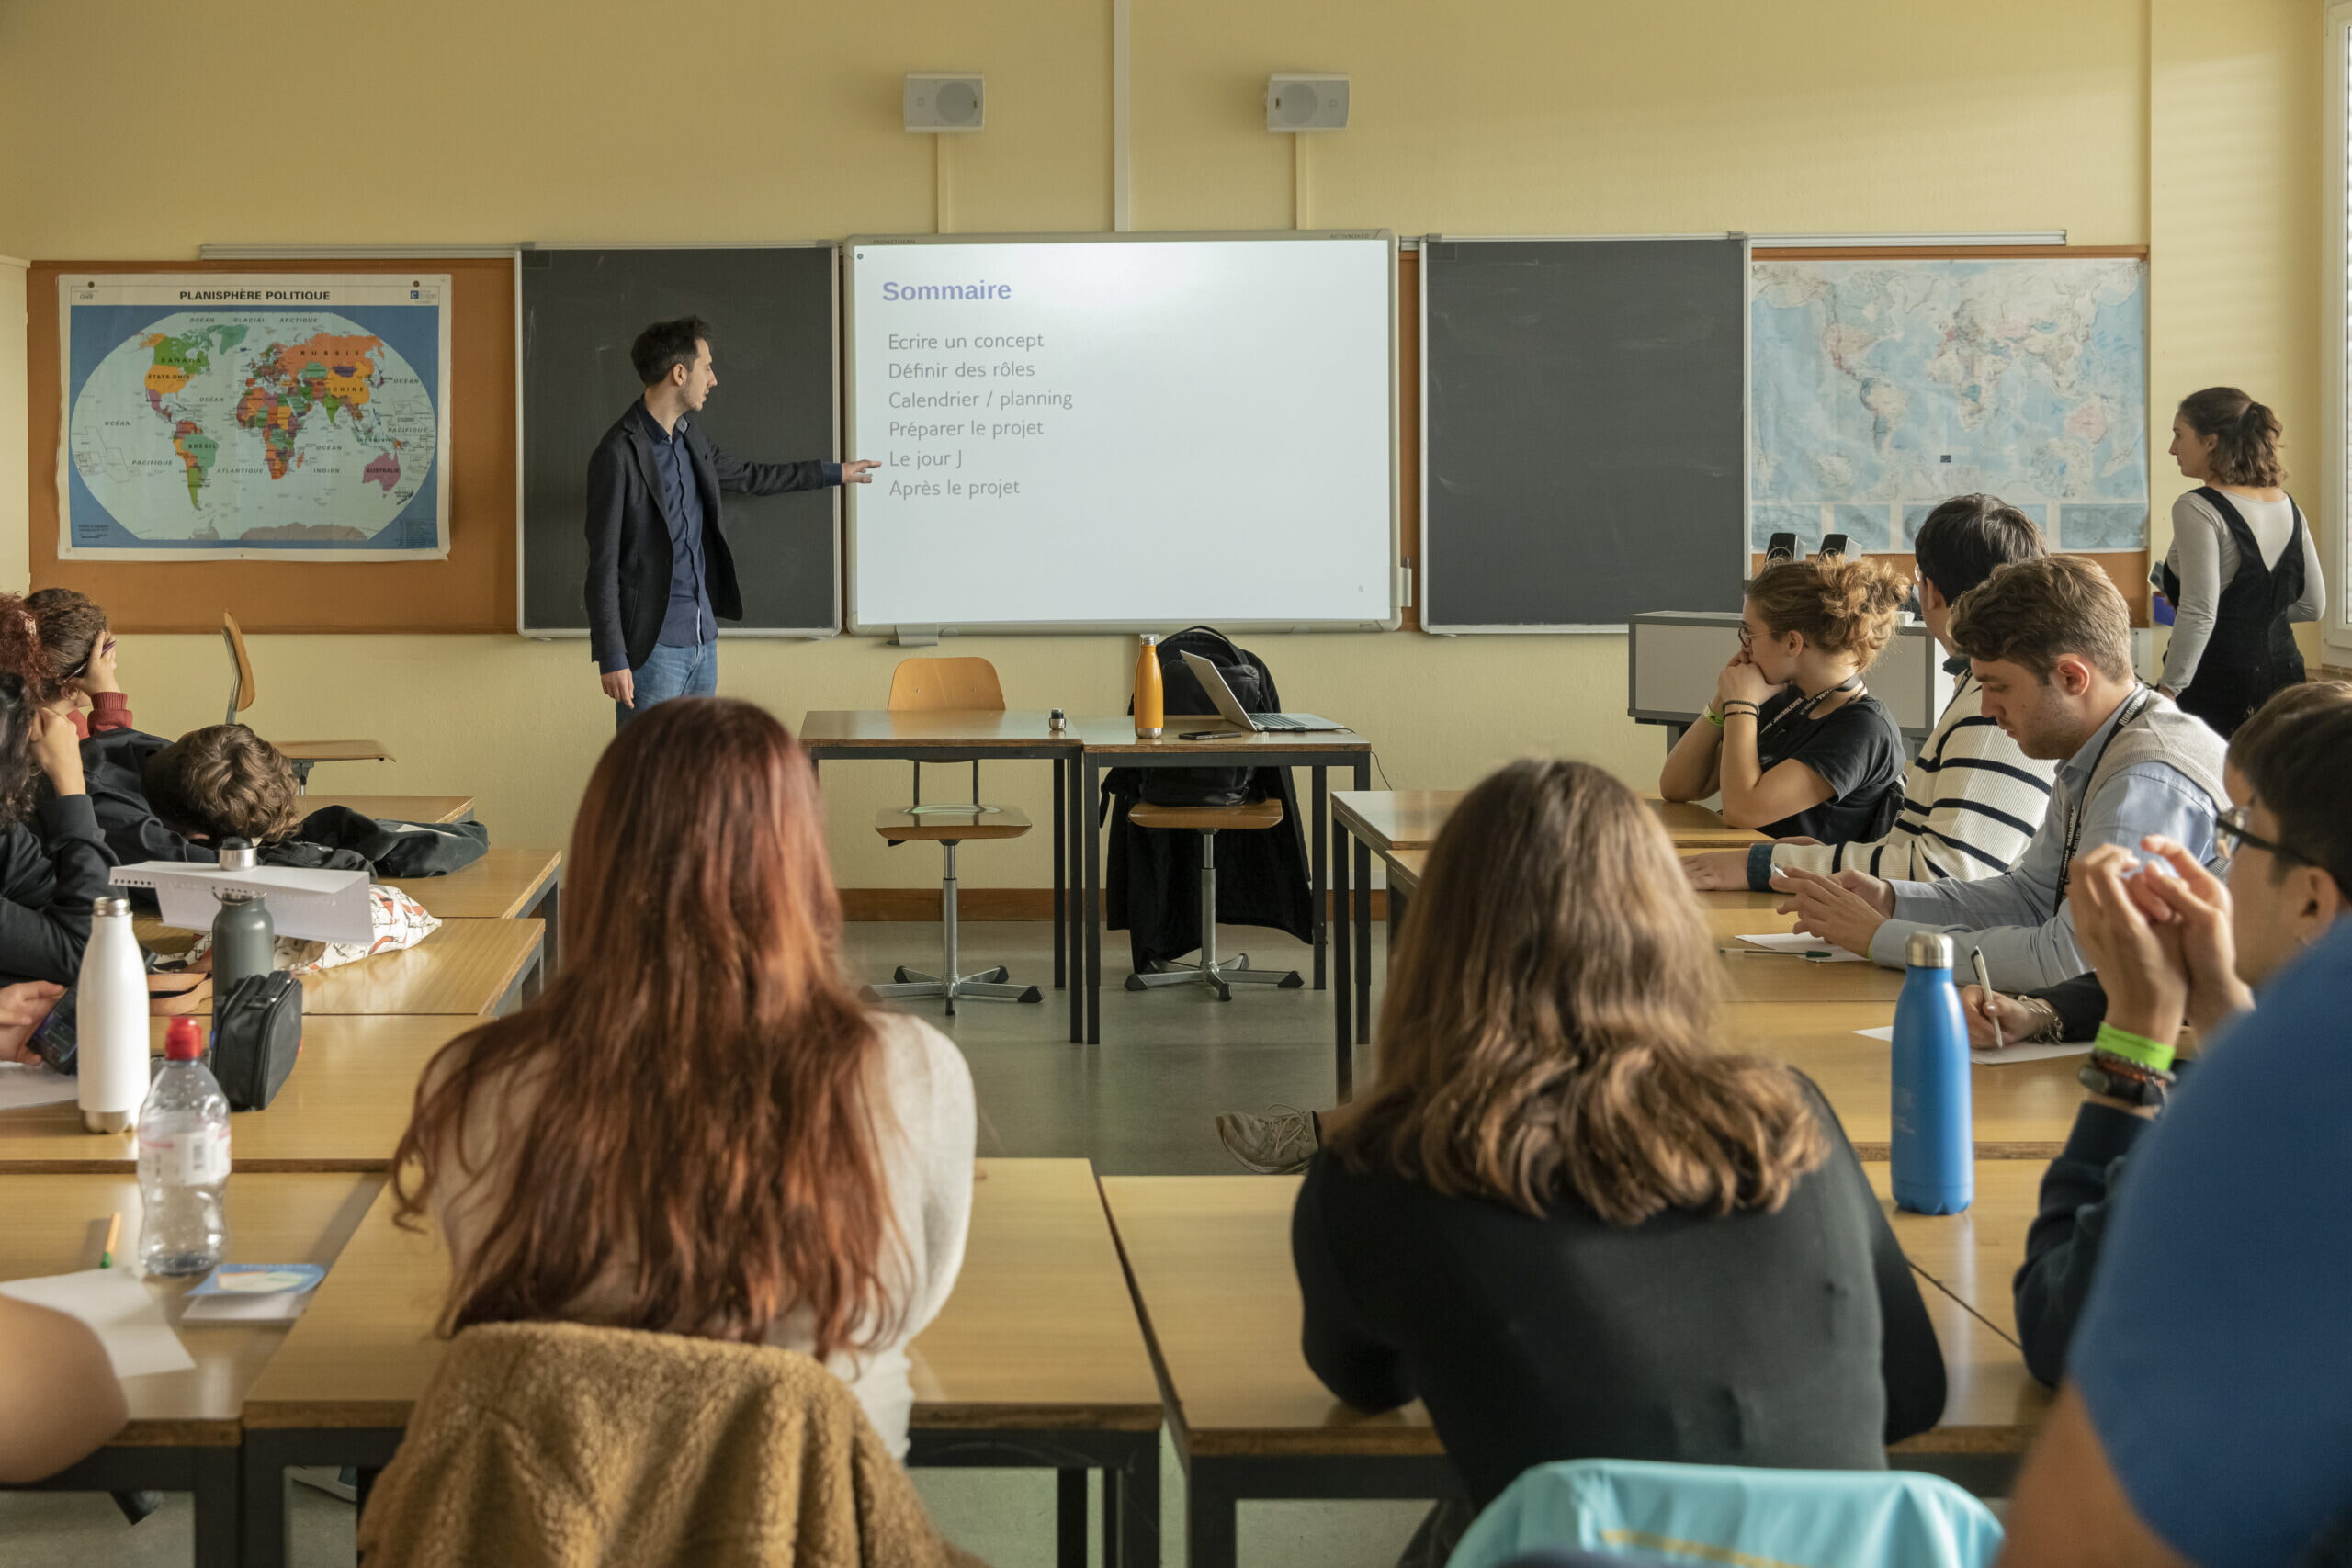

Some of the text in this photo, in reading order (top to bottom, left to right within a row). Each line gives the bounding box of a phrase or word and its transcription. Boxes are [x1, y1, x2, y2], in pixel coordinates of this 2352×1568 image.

[179, 288, 331, 300] PLANISPHÈRE POLITIQUE
[882, 280, 1012, 301] Sommaire
[888, 333, 1045, 352] Ecrire un concept
[888, 361, 1035, 378] Définir des rôles
[888, 390, 1073, 411] Calendrier / planning
[889, 419, 1044, 441] Préparer le projet
[889, 449, 963, 471] Le jour J
[889, 478, 1020, 501] Après le projet
